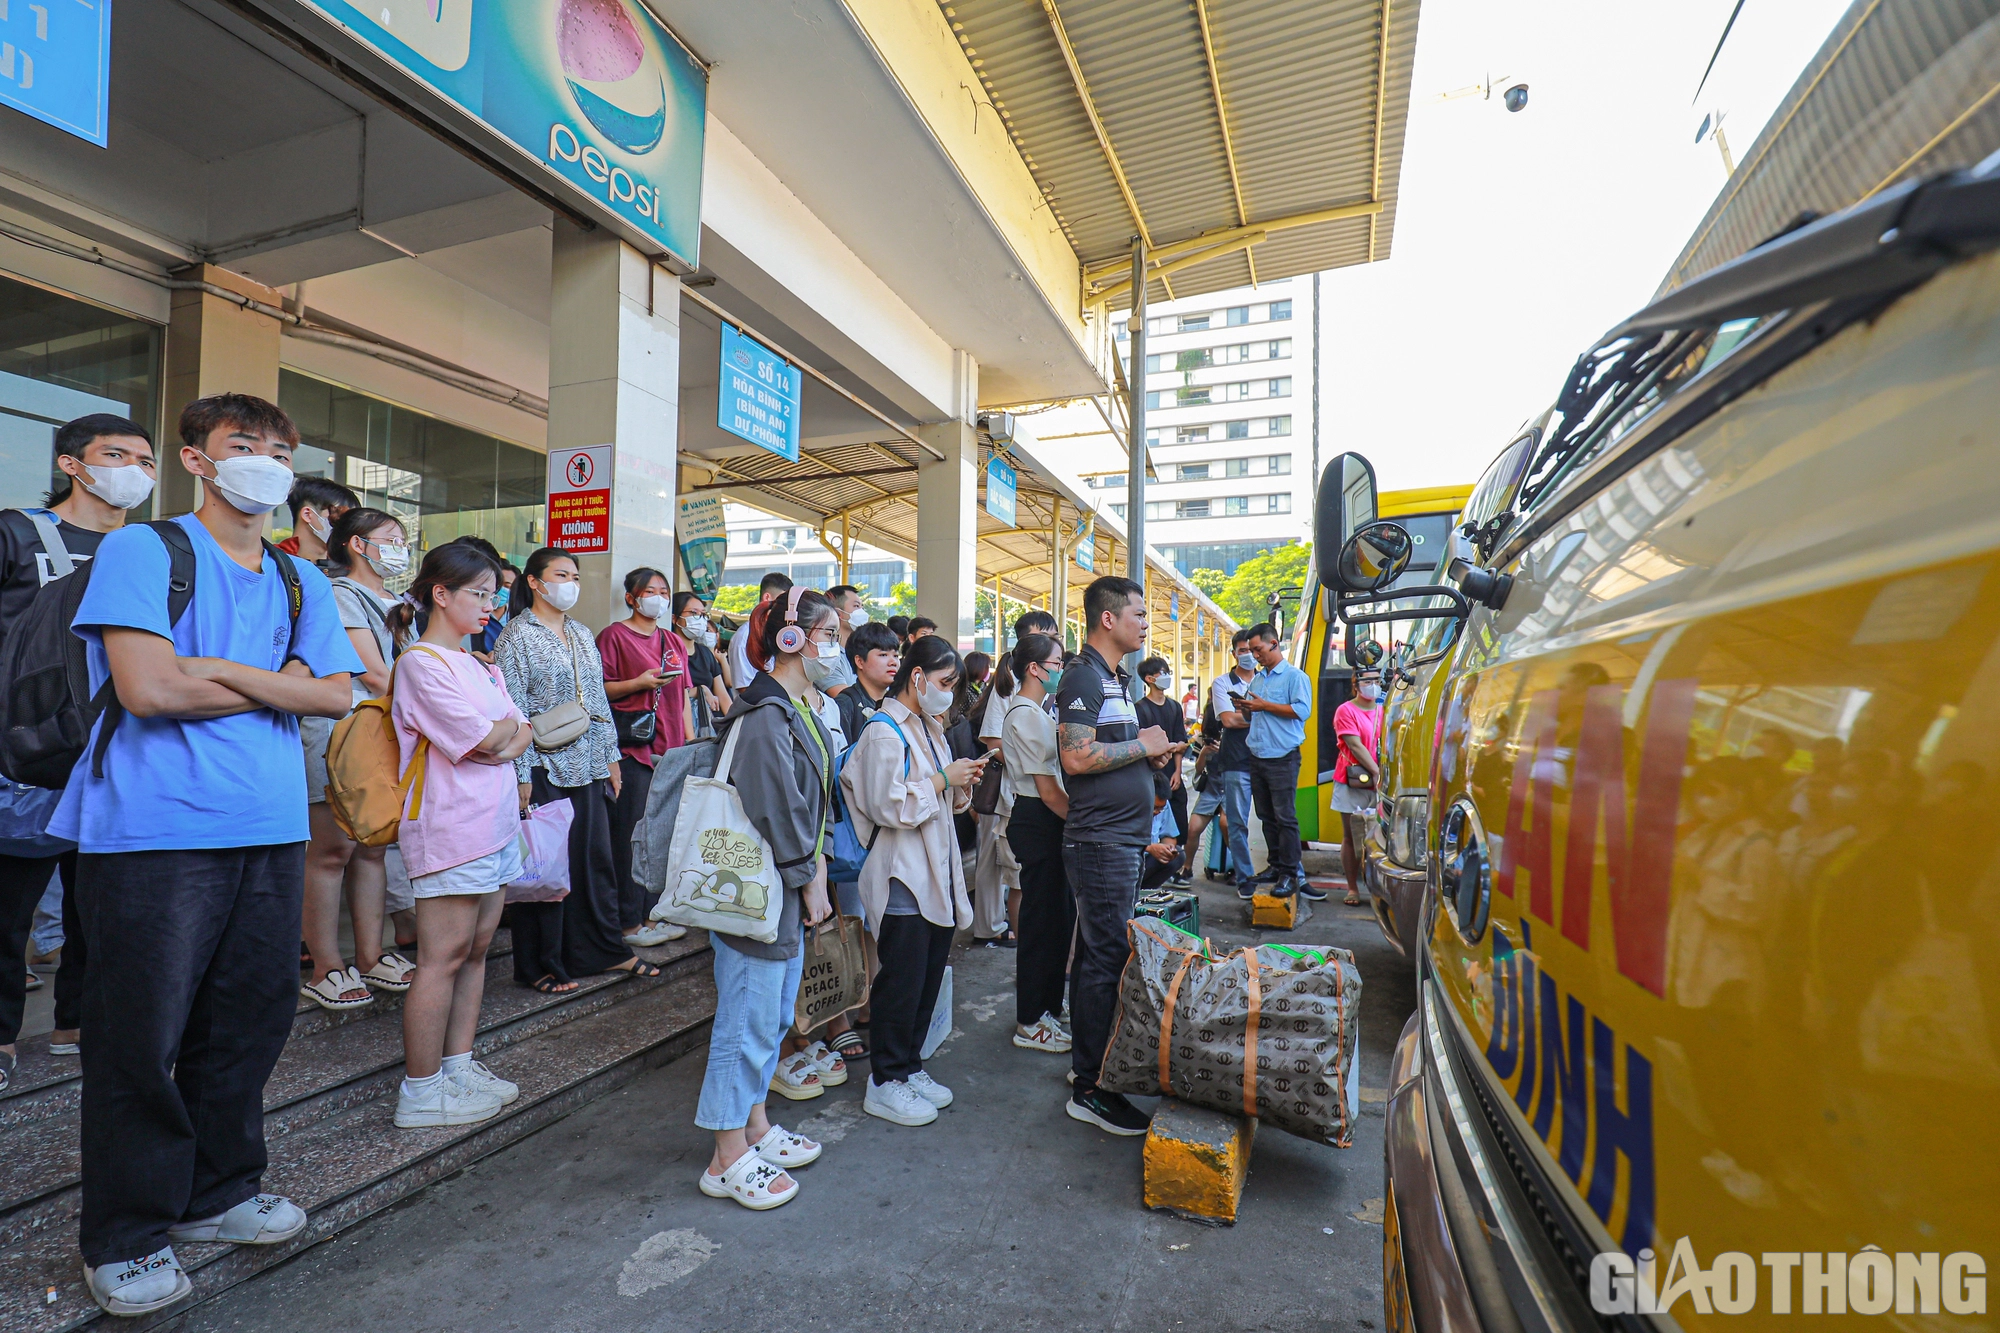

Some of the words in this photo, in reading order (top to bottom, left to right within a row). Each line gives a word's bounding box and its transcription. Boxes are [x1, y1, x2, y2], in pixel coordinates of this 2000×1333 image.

[549, 123, 662, 225] pepsi
[757, 360, 774, 384] SỐ
[776, 372, 790, 393] 14
[732, 375, 755, 399] HÒA
[757, 391, 782, 413] BÌNH
[783, 405, 790, 417] 2
[736, 397, 766, 422] (BÌNH
[768, 414, 786, 434] AN)
[734, 414, 750, 436] DỰ
[752, 427, 786, 450] PHÒNG
[572, 498, 582, 506] CAO
[562, 520, 594, 535] KHÔNG
[713, 828, 731, 839] you
[802, 961, 833, 982] LOVE
[804, 975, 840, 998] PEACE
[805, 990, 844, 1016] COFFEE
[257, 1196, 285, 1216] TikTok
[116, 1256, 172, 1282] TikTok
